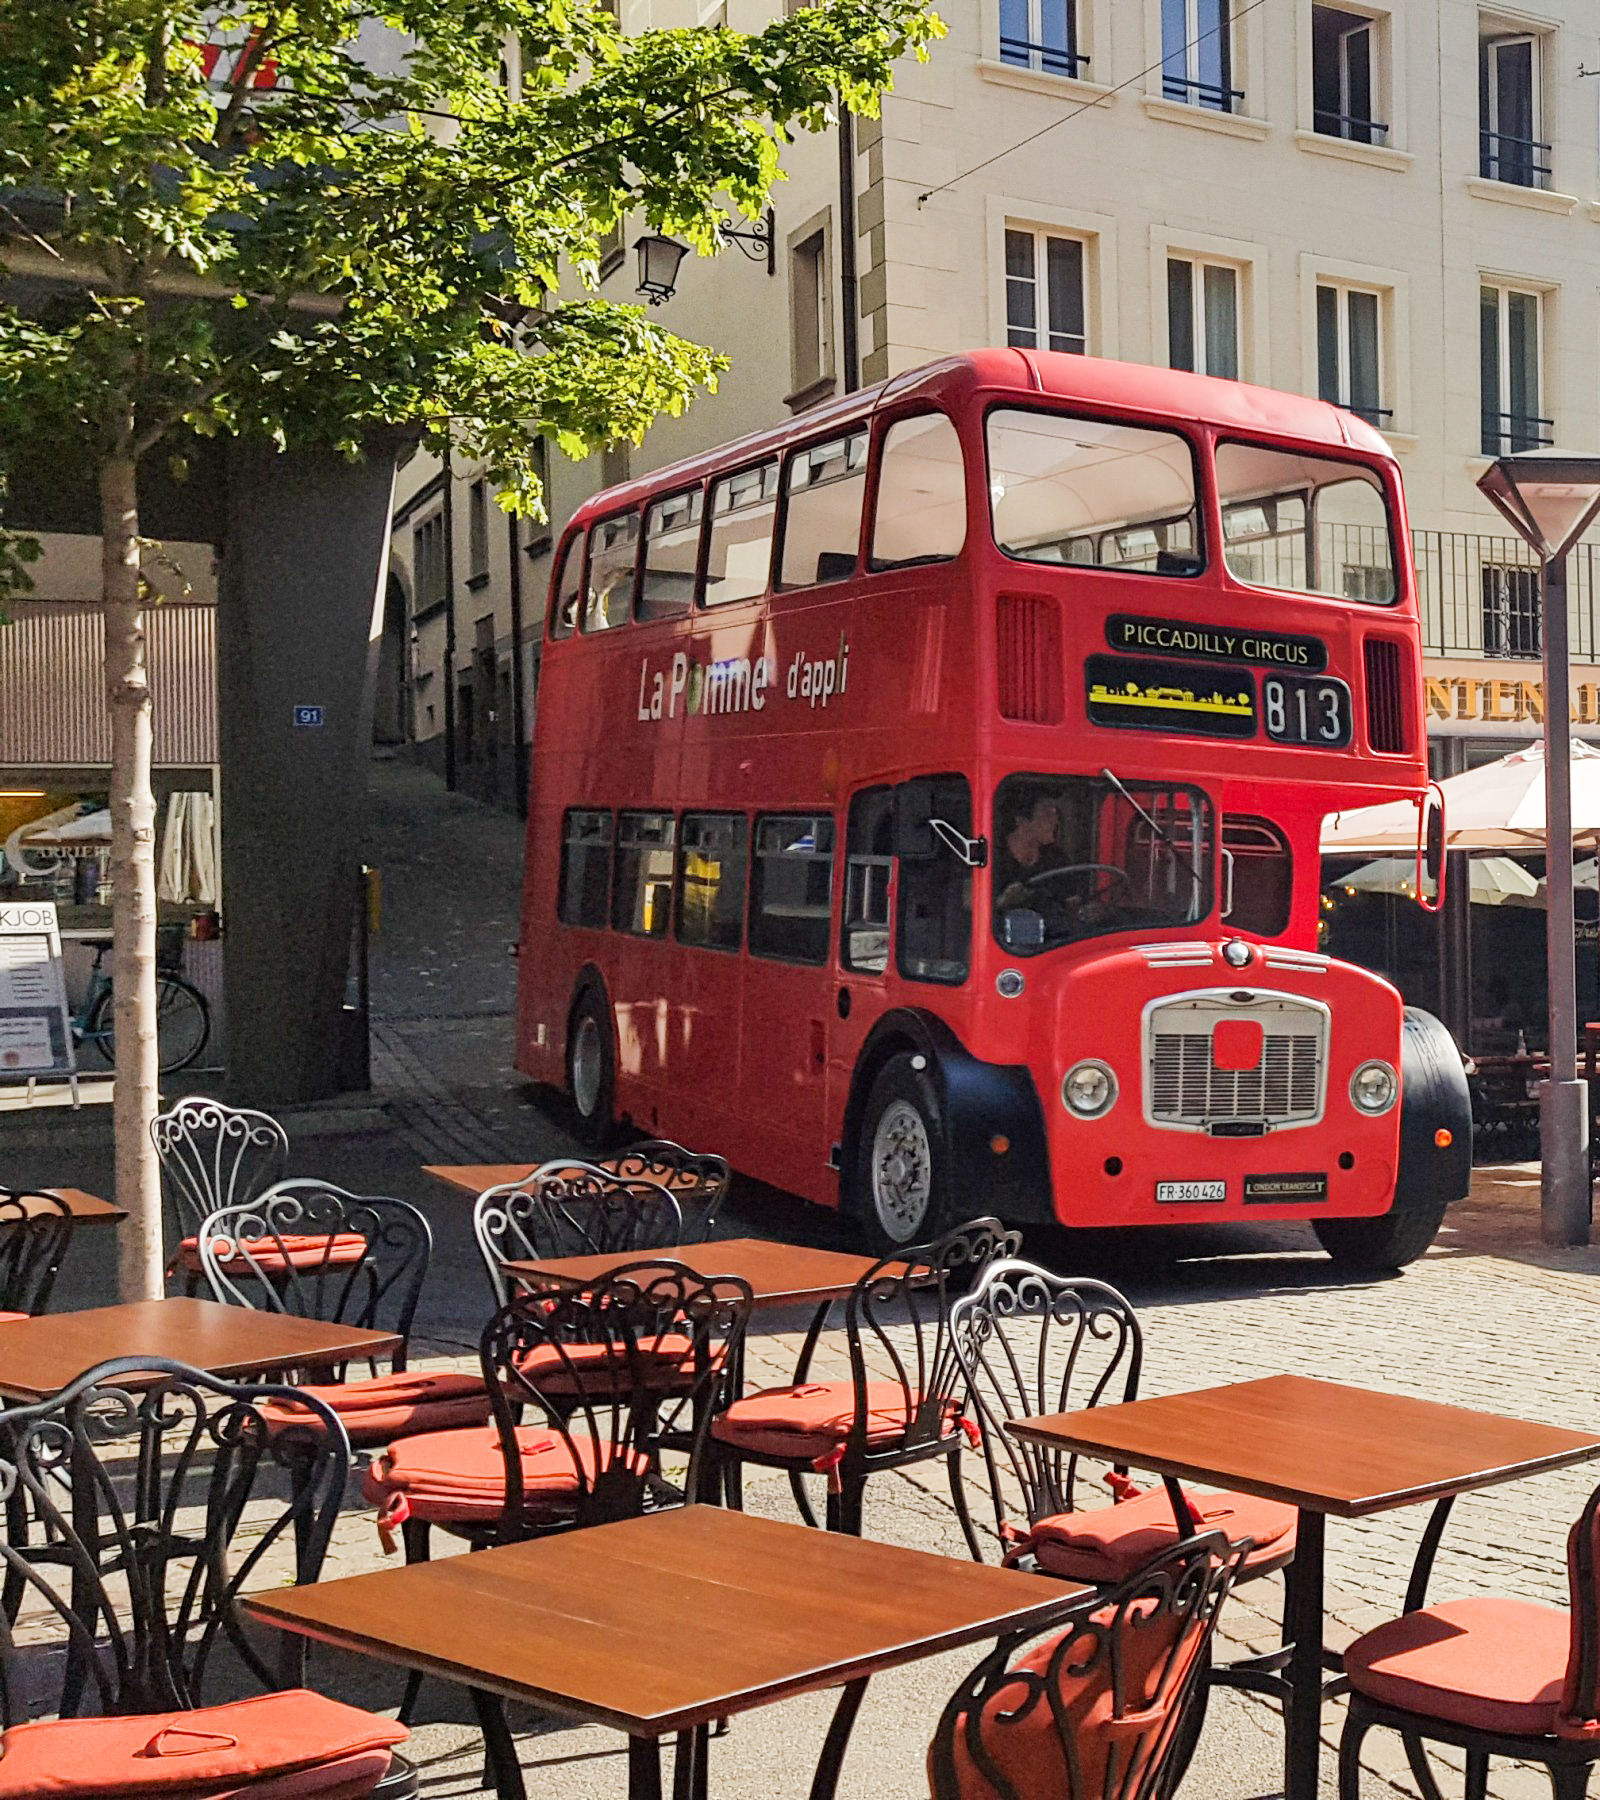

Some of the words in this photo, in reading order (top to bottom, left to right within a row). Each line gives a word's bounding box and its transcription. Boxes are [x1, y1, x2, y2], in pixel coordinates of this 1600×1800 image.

[1123, 623, 1236, 654] PICCADILLY
[1241, 639, 1309, 664] CIRCUS
[637, 658, 664, 721] La
[1265, 680, 1341, 742] 813
[300, 709, 318, 723] 91
